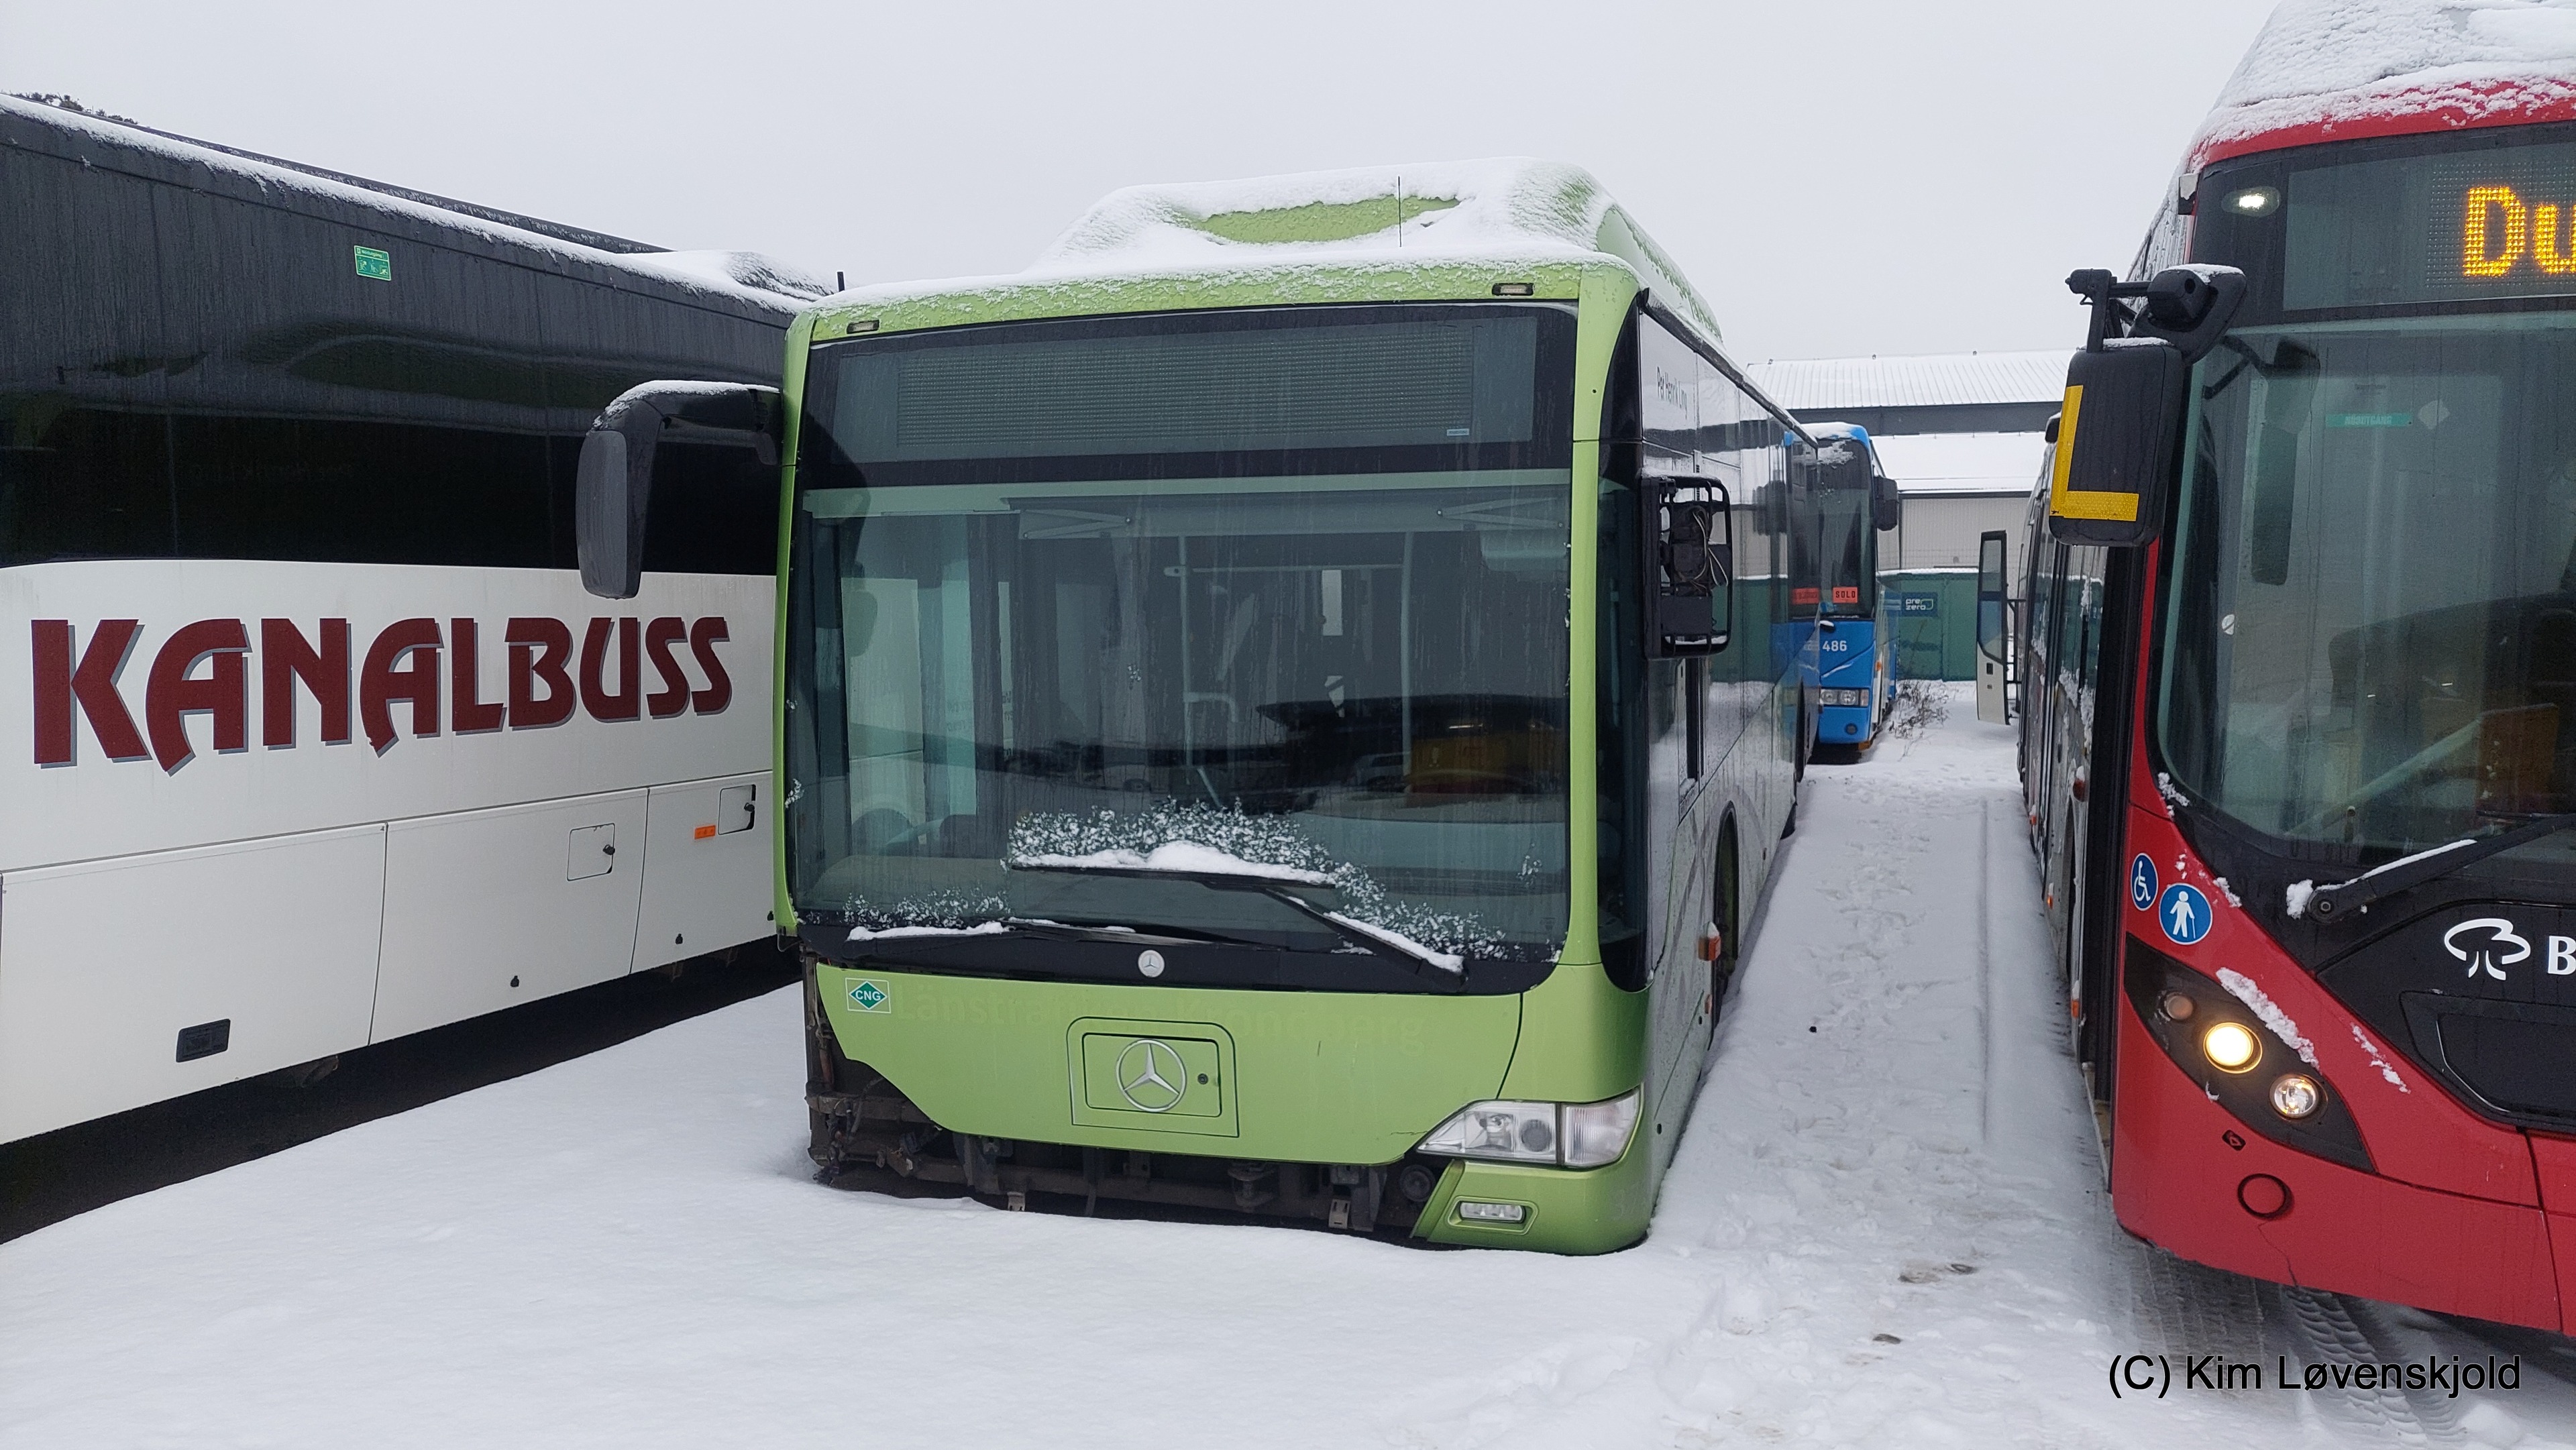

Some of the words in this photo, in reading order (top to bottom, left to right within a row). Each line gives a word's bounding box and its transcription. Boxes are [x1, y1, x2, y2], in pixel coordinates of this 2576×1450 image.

[1822, 640, 1847, 652] 486
[31, 617, 732, 777] KANALBUSS
[855, 990, 881, 1001] CNG
